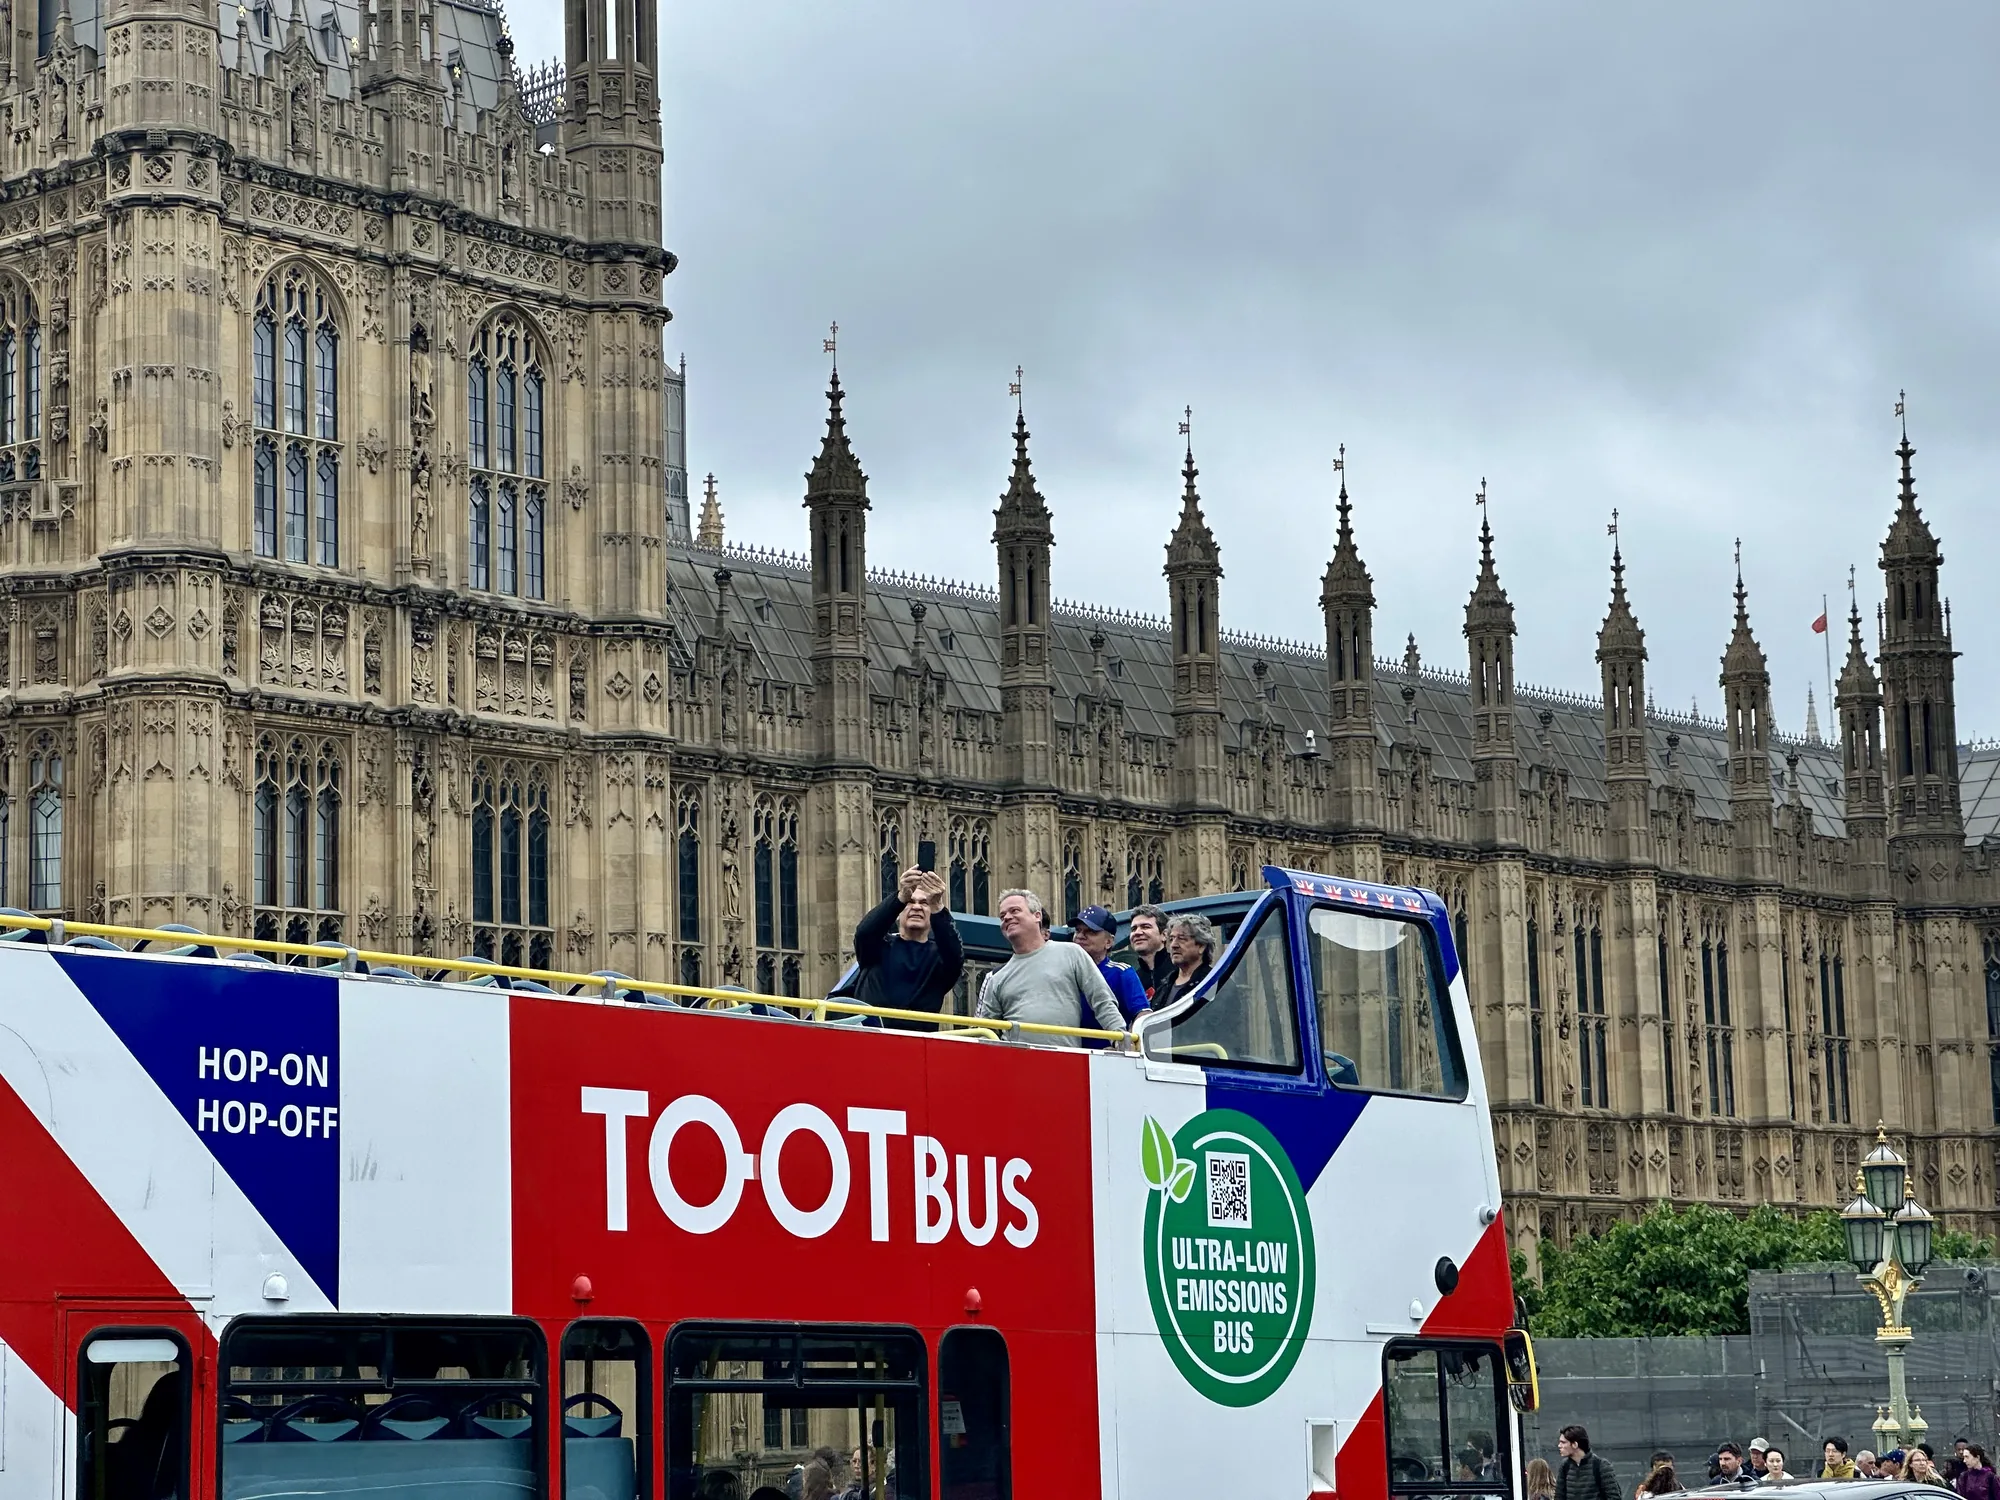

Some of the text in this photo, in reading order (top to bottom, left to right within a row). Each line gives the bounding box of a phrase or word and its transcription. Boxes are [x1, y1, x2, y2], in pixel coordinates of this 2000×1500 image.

[198, 1046, 329, 1088] HOP-ON
[198, 1098, 338, 1139] HOP-OFF
[1172, 1237, 1288, 1274] ULTRA-LOW
[1176, 1278, 1288, 1315] EMISSIONS
[1214, 1320, 1254, 1354] BUS
